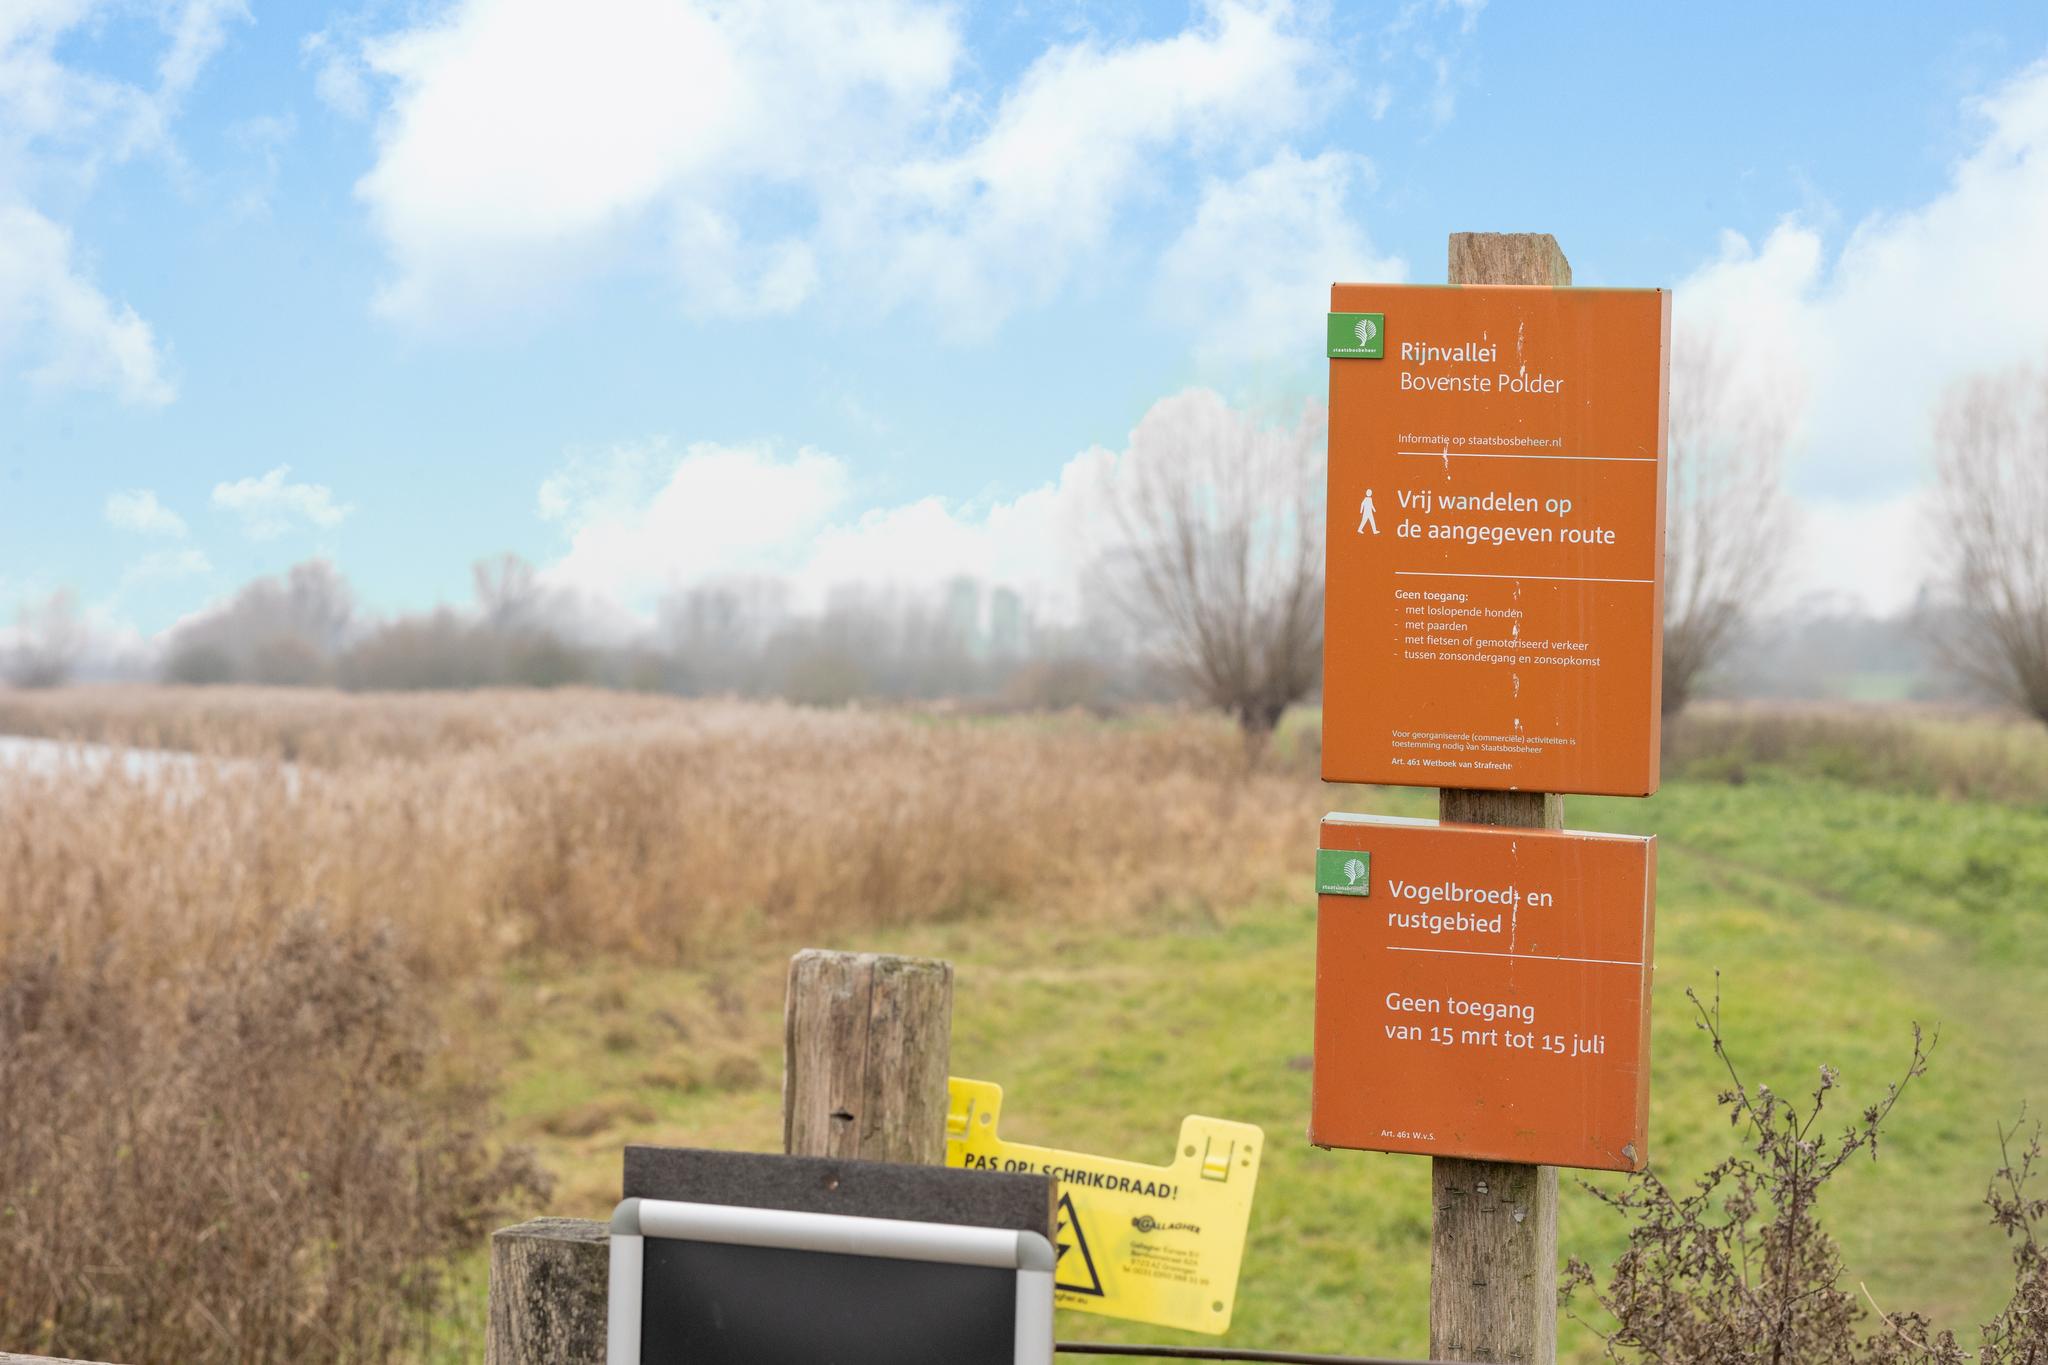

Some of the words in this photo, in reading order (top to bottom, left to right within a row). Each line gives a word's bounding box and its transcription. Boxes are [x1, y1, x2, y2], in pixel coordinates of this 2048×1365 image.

[1402, 342, 1496, 365] Rijnvallei
[1401, 372, 1491, 392] Bovenste
[1499, 373, 1563, 393] Polder
[1399, 433, 1450, 446] Informatie
[1453, 436, 1465, 449] op
[1468, 436, 1561, 449] staatsbosbeheer.nl
[1398, 490, 1431, 513] Vrij
[1439, 492, 1538, 512] wandelen
[1546, 499, 1571, 517] op
[1397, 519, 1421, 538] de
[1428, 525, 1552, 545] aangegeven
[1560, 527, 1615, 544] route
[1395, 590, 1420, 599] Geen
[1424, 592, 1468, 603] toegang:
[1428, 606, 1481, 617] loslopende
[1485, 608, 1522, 618] honden
[1406, 621, 1424, 629] met
[1428, 622, 1467, 631] paarden
[1405, 636, 1424, 644] met
[1427, 635, 1459, 645] fietsen
[1463, 637, 1472, 646] of
[1476, 637, 1548, 651] gemotoriseerd
[1552, 641, 1588, 650] verkeer
[1405, 650, 1436, 659] tussen
[1439, 652, 1516, 665] zonsondergang
[1534, 656, 1600, 666] zonsopkomst
[1392, 730, 1410, 738] Voor
[1411, 733, 1470, 741] georganiseerde
[1392, 739, 1440, 750] toestemming
[1443, 742, 1464, 752] nodig
[1392, 758, 1405, 766] Art.
[1423, 759, 1456, 767] Wetboek
[1527, 893, 1553, 906] en
[1389, 912, 1501, 934] rustgebied
[1386, 993, 1440, 1012] Geen
[1448, 997, 1534, 1024] toegang
[1385, 1025, 1422, 1040] van
[1431, 1027, 1453, 1045] 15
[1462, 1029, 1497, 1046] mrt
[1505, 1031, 1534, 1048] tot
[1542, 1035, 1565, 1054] 15
[1571, 1034, 1604, 1056] juli
[964, 1152, 998, 1171] PAS
[1042, 1165, 1179, 1200] SCHRIKDRAAD!
